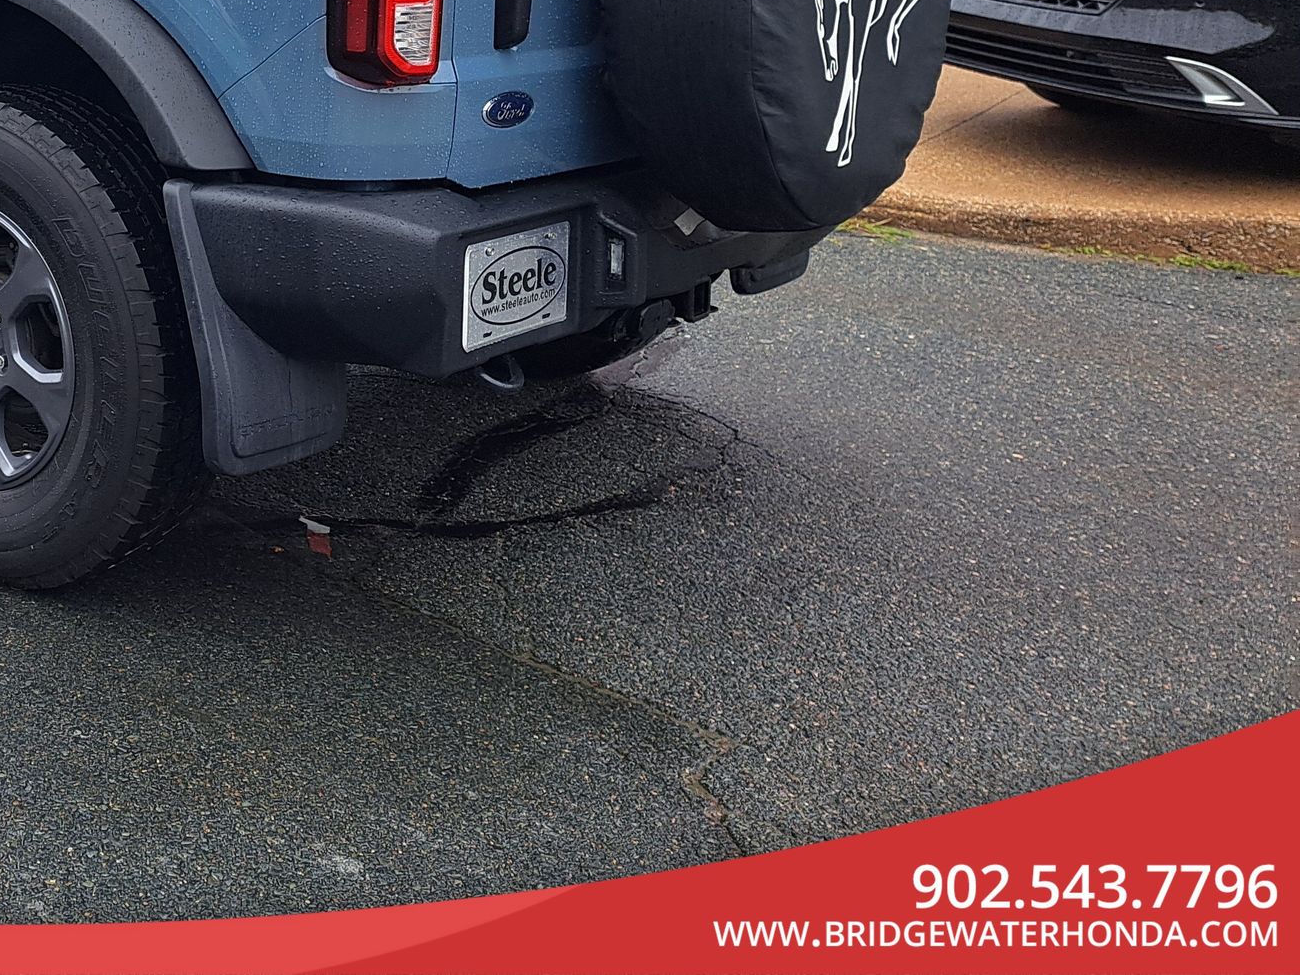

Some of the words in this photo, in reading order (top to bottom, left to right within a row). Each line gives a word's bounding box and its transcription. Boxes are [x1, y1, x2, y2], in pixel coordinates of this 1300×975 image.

[497, 101, 526, 121] Ford
[480, 257, 558, 306] Steele
[480, 287, 557, 318] www.steeleauto.com
